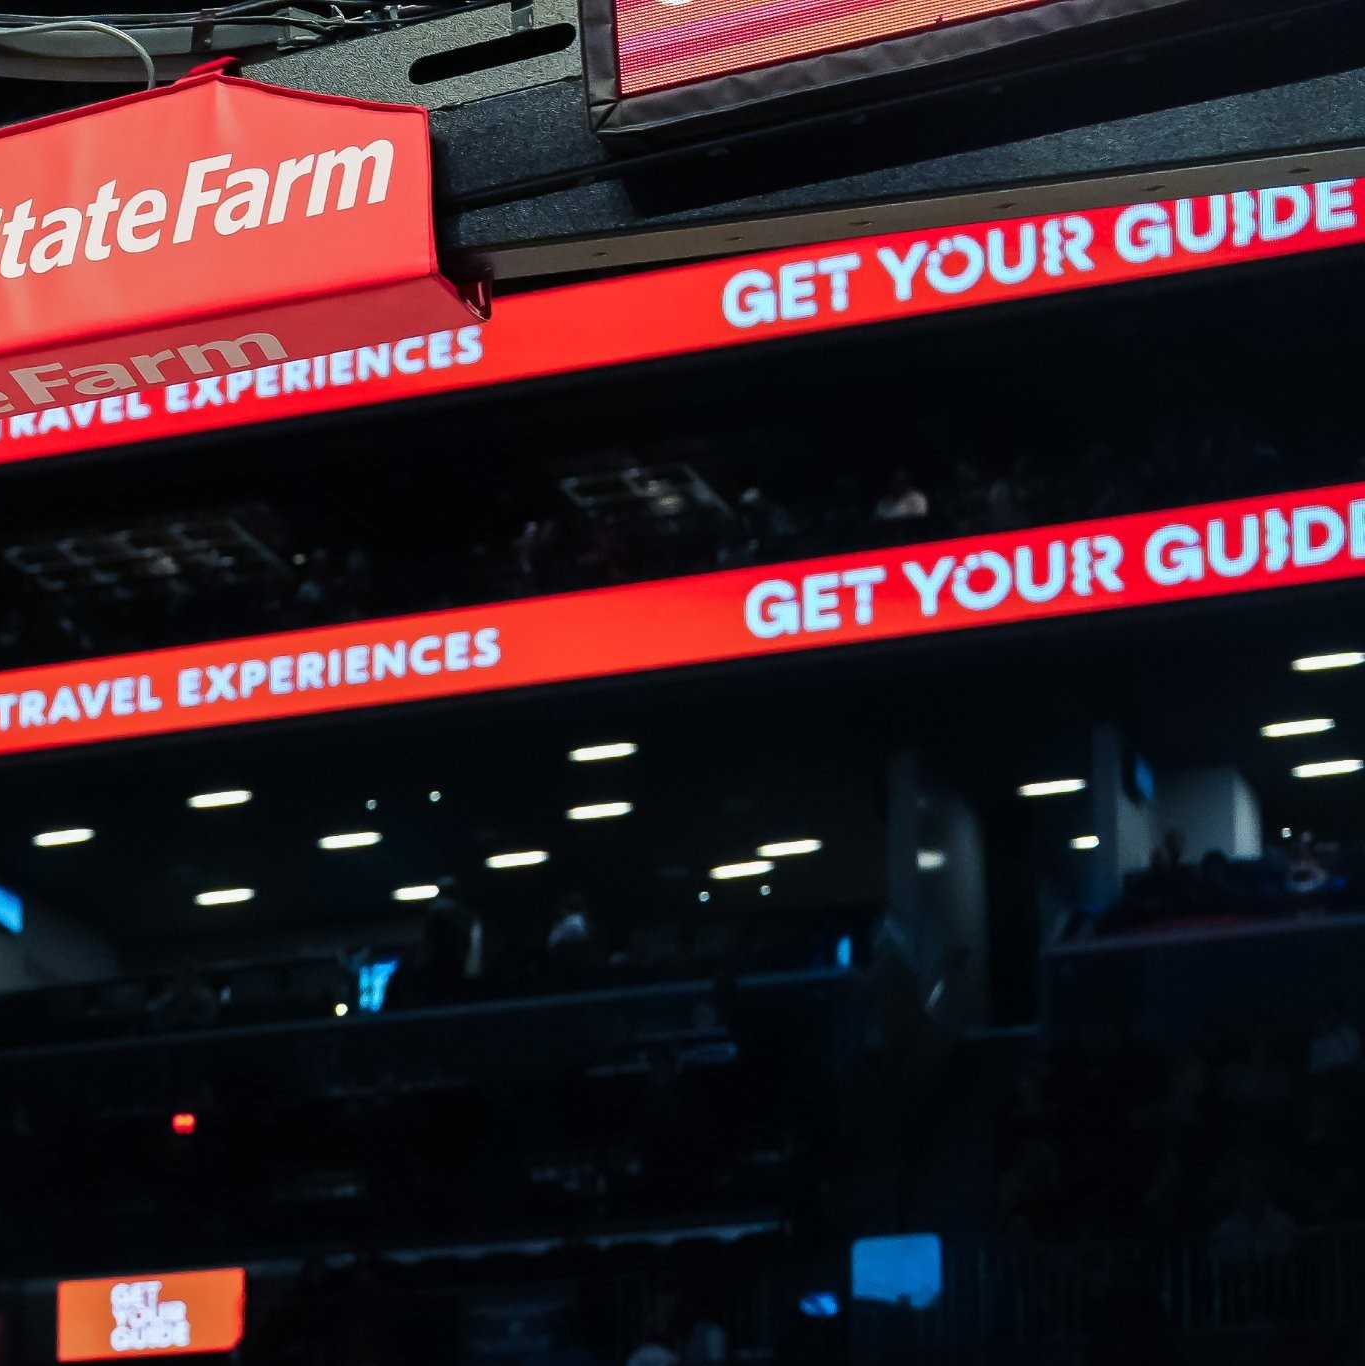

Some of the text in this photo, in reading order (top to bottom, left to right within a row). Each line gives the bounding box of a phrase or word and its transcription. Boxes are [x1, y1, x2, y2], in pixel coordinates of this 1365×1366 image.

[174, 138, 394, 243] Farm
[722, 177, 1356, 329] GET YOUR GUIDE
[10, 332, 289, 404] Farm
[166, 324, 483, 413] EXPERIENCES
[744, 566, 886, 641] GET
[902, 534, 1125, 617] YOUR
[177, 627, 501, 707] EXPERIENCES
